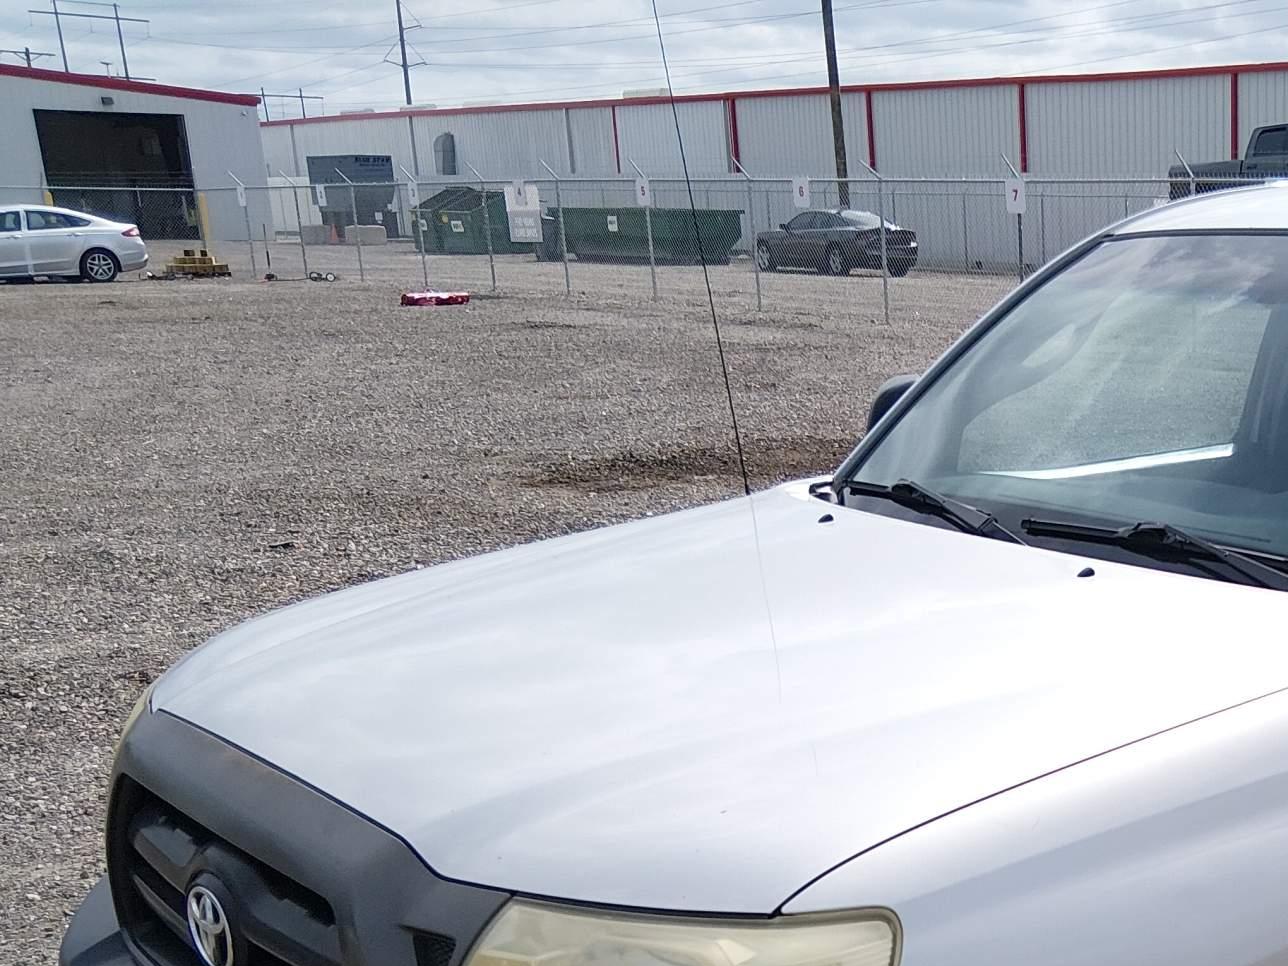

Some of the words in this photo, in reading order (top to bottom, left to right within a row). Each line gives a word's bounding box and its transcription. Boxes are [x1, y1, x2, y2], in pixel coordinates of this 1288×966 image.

[640, 186, 646, 197] 5
[798, 186, 805, 197] 6
[1012, 189, 1018, 201] 7
